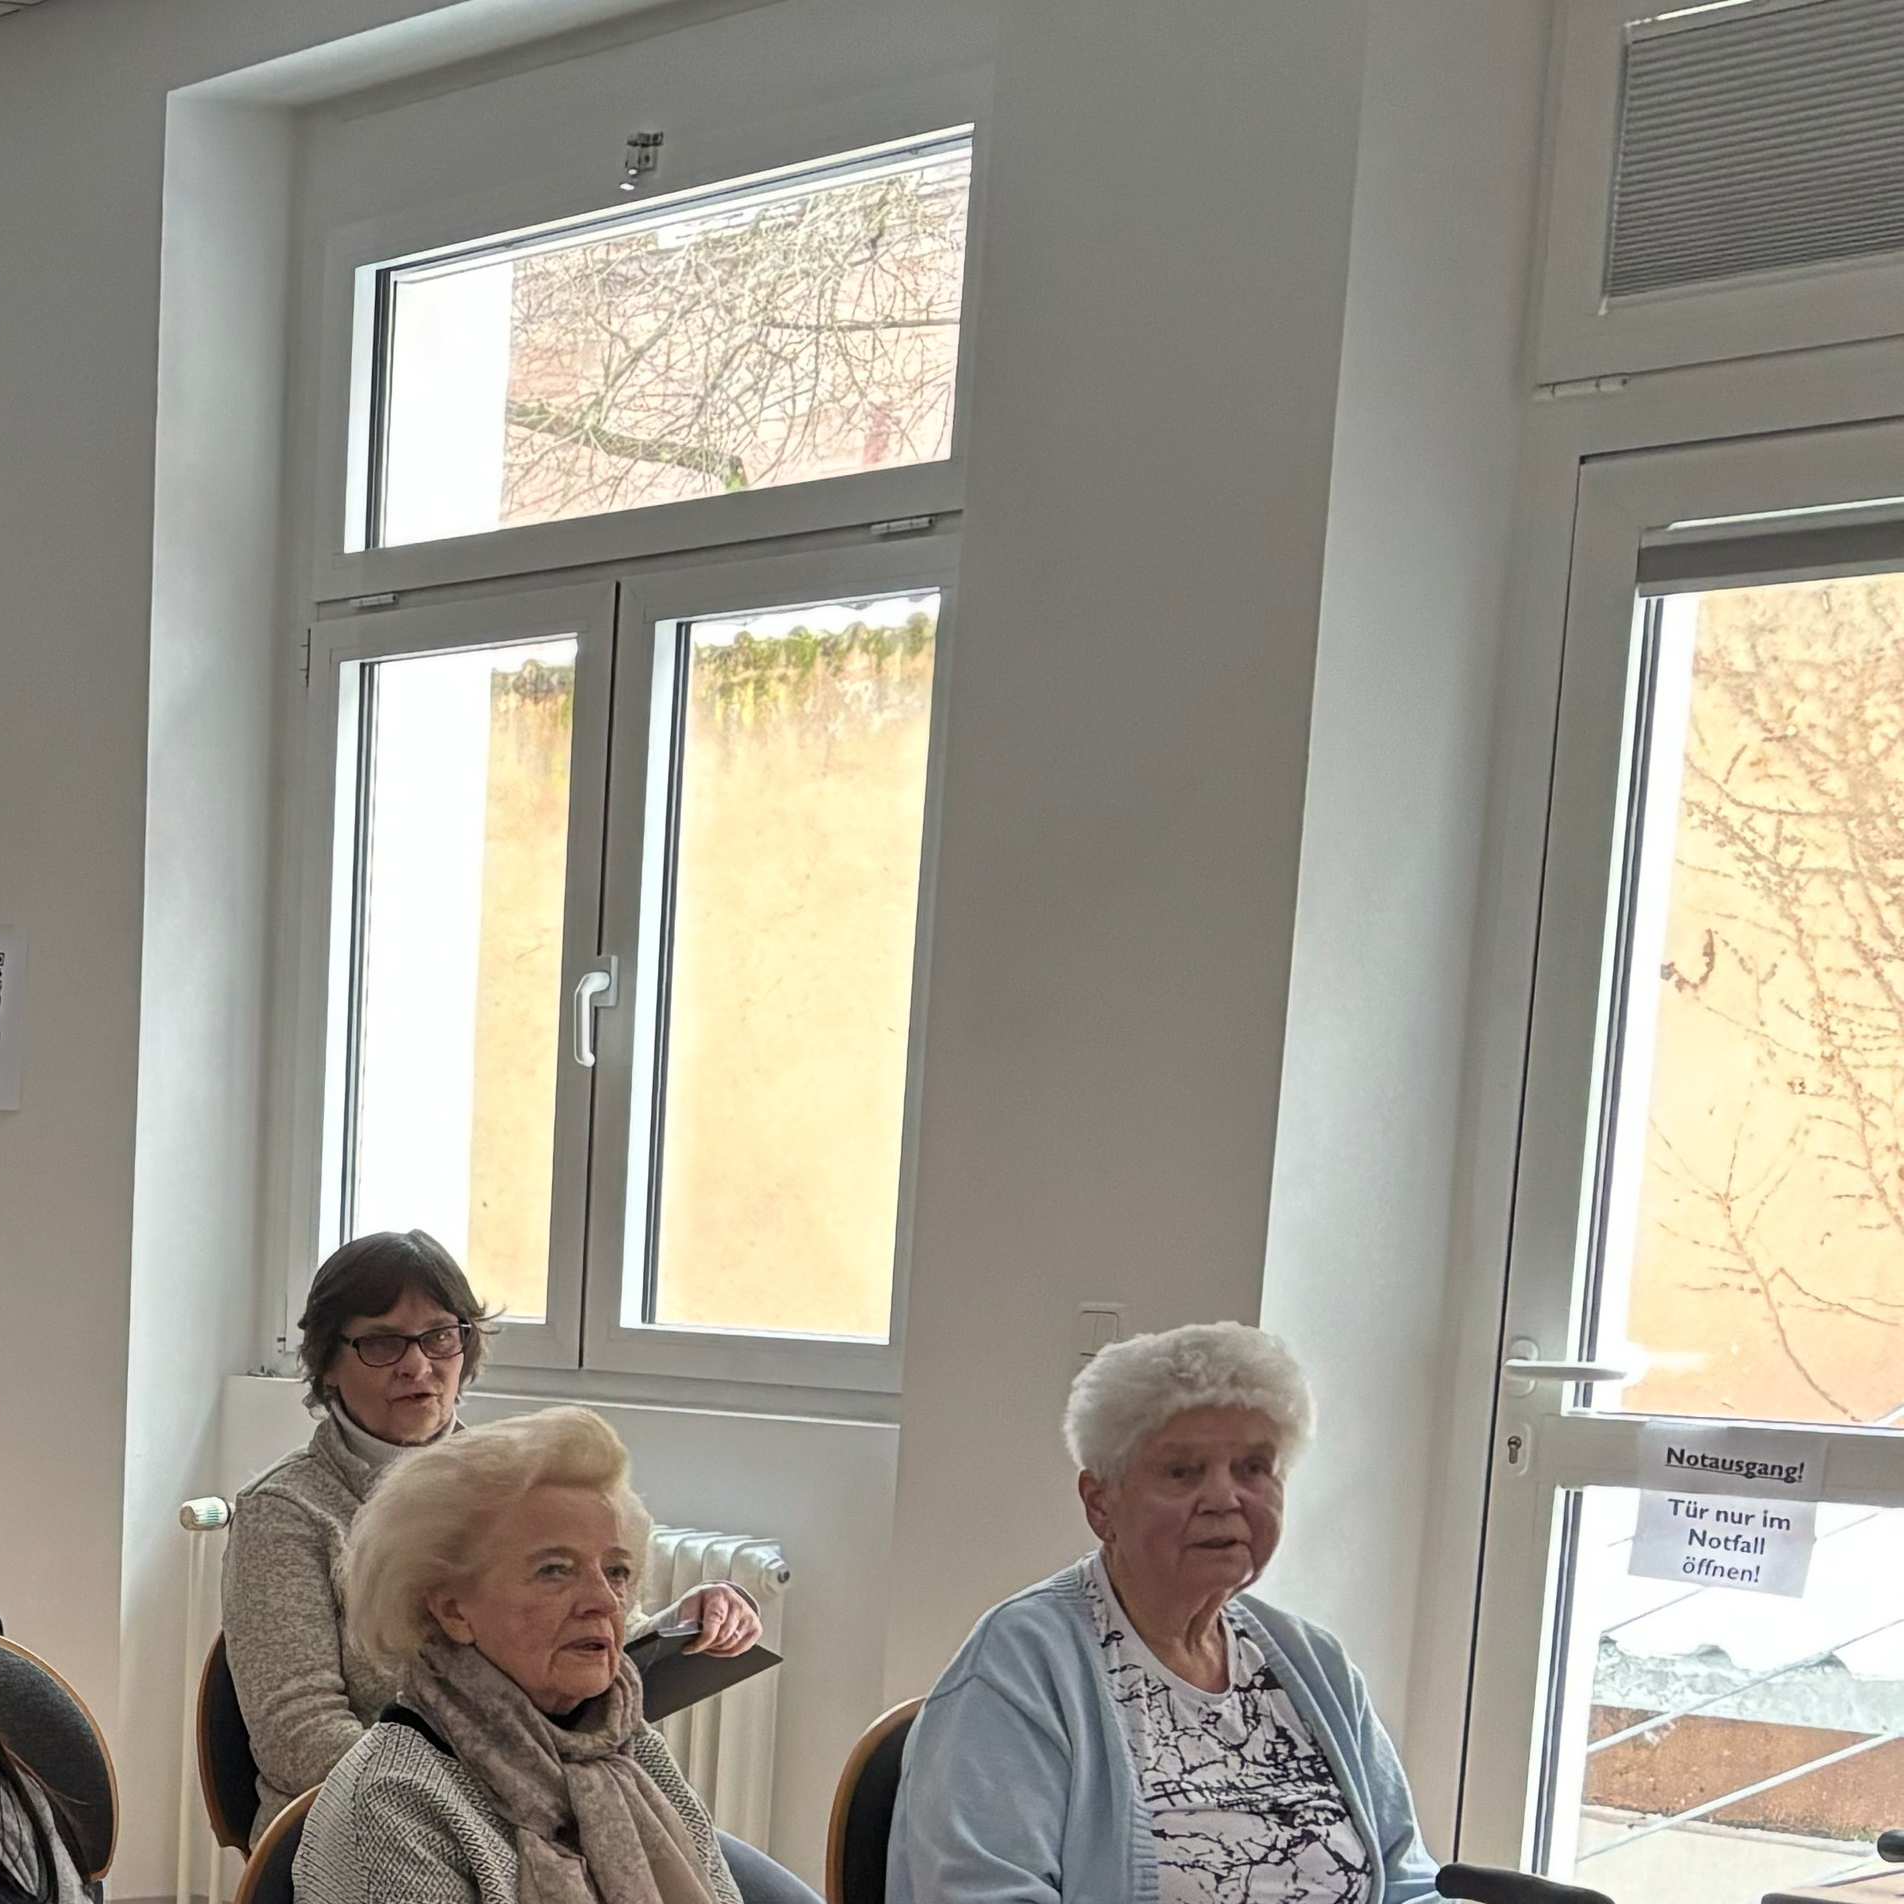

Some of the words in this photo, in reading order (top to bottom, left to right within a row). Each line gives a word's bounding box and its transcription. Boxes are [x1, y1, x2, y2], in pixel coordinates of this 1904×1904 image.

[1666, 1447, 1805, 1483] Notausgang!
[1667, 1498, 1709, 1520] Tür
[1715, 1509, 1755, 1527] nur
[1762, 1510, 1791, 1531] im
[1688, 1528, 1766, 1555] Notfall
[1682, 1555, 1761, 1583] öffnen!
